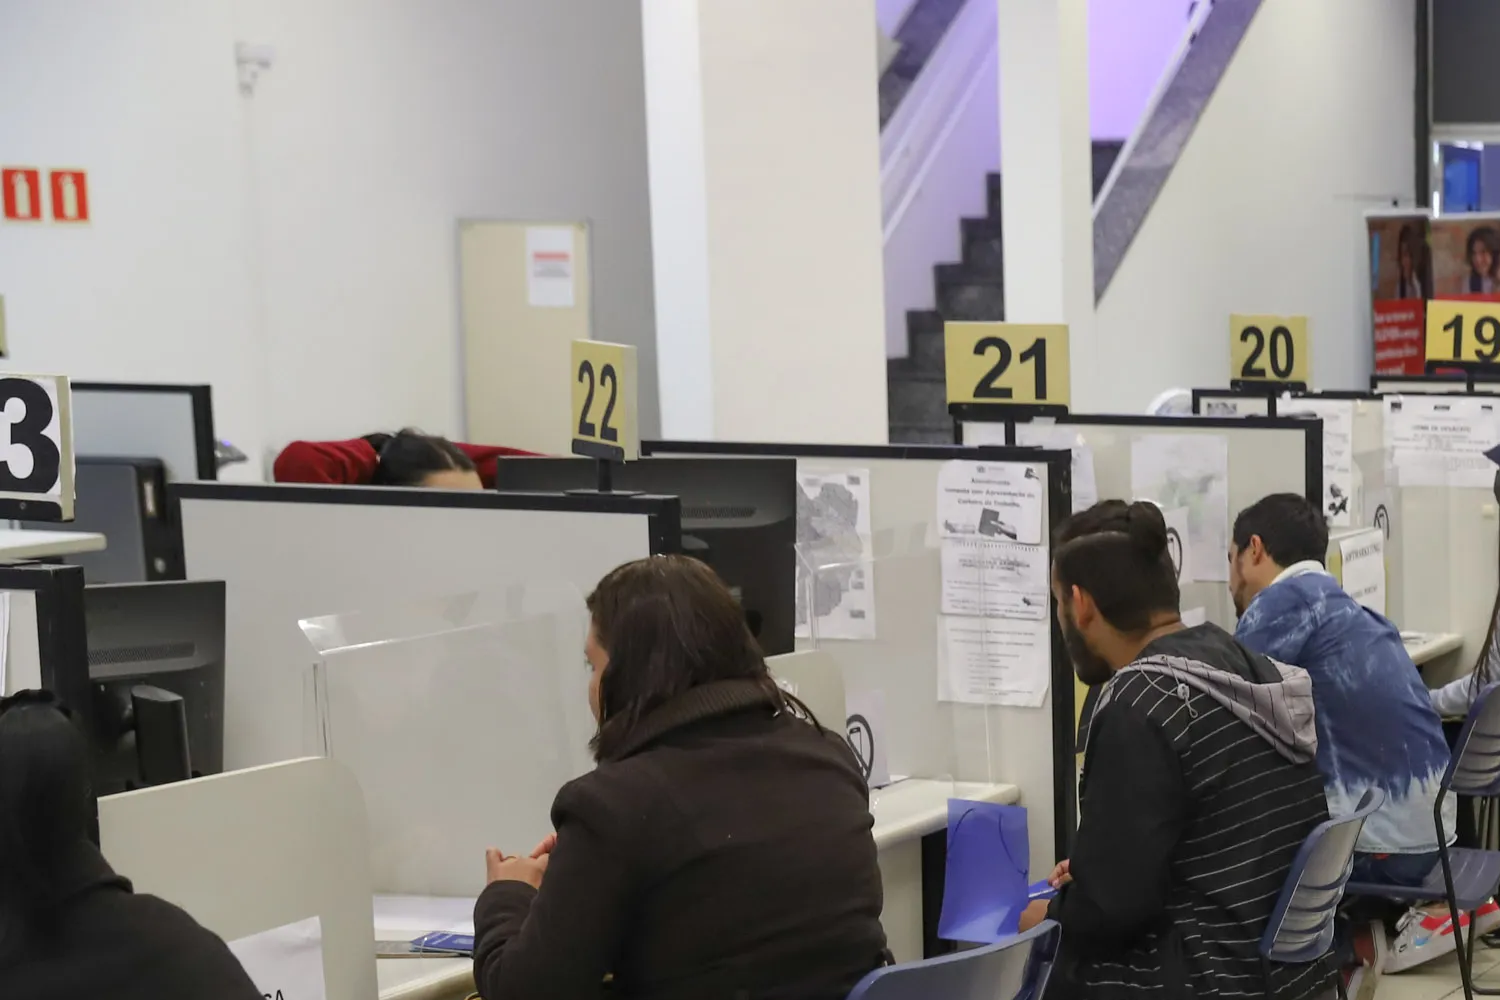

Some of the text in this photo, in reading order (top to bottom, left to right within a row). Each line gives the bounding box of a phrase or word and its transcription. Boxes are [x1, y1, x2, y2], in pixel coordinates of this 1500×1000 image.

[973, 337, 1047, 400] 21
[1239, 325, 1295, 380] 20
[578, 360, 618, 442] 22
